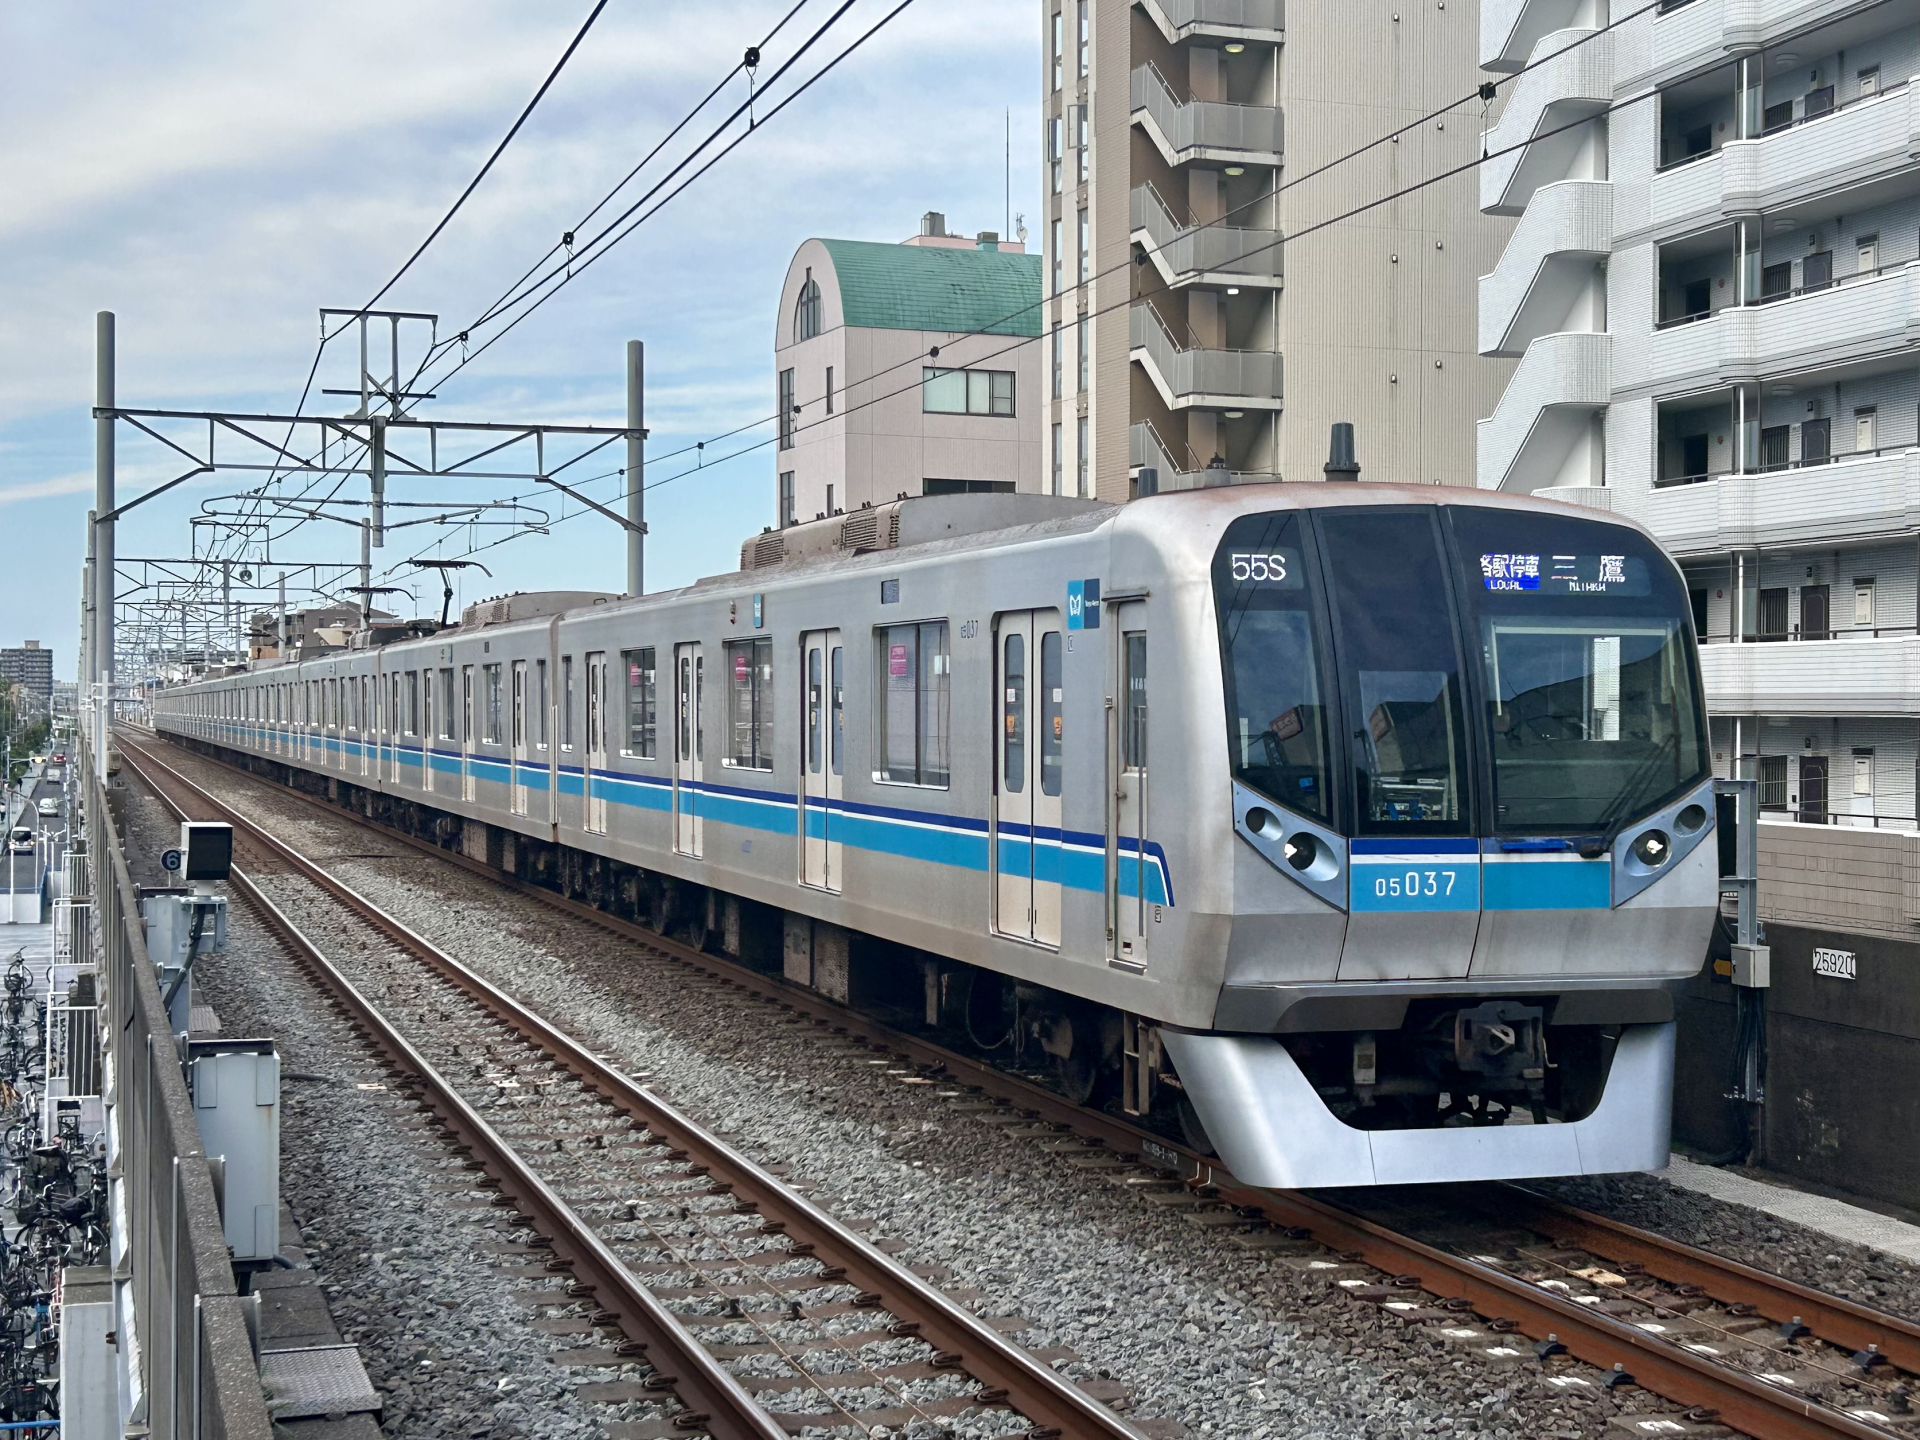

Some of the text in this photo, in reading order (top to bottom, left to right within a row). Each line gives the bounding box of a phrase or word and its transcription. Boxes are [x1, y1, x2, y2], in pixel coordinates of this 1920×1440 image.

[1232, 553, 1287, 581] 55S
[166, 851, 179, 869] 6
[1375, 871, 1456, 897] 05037
[1814, 950, 1854, 976] 25920
